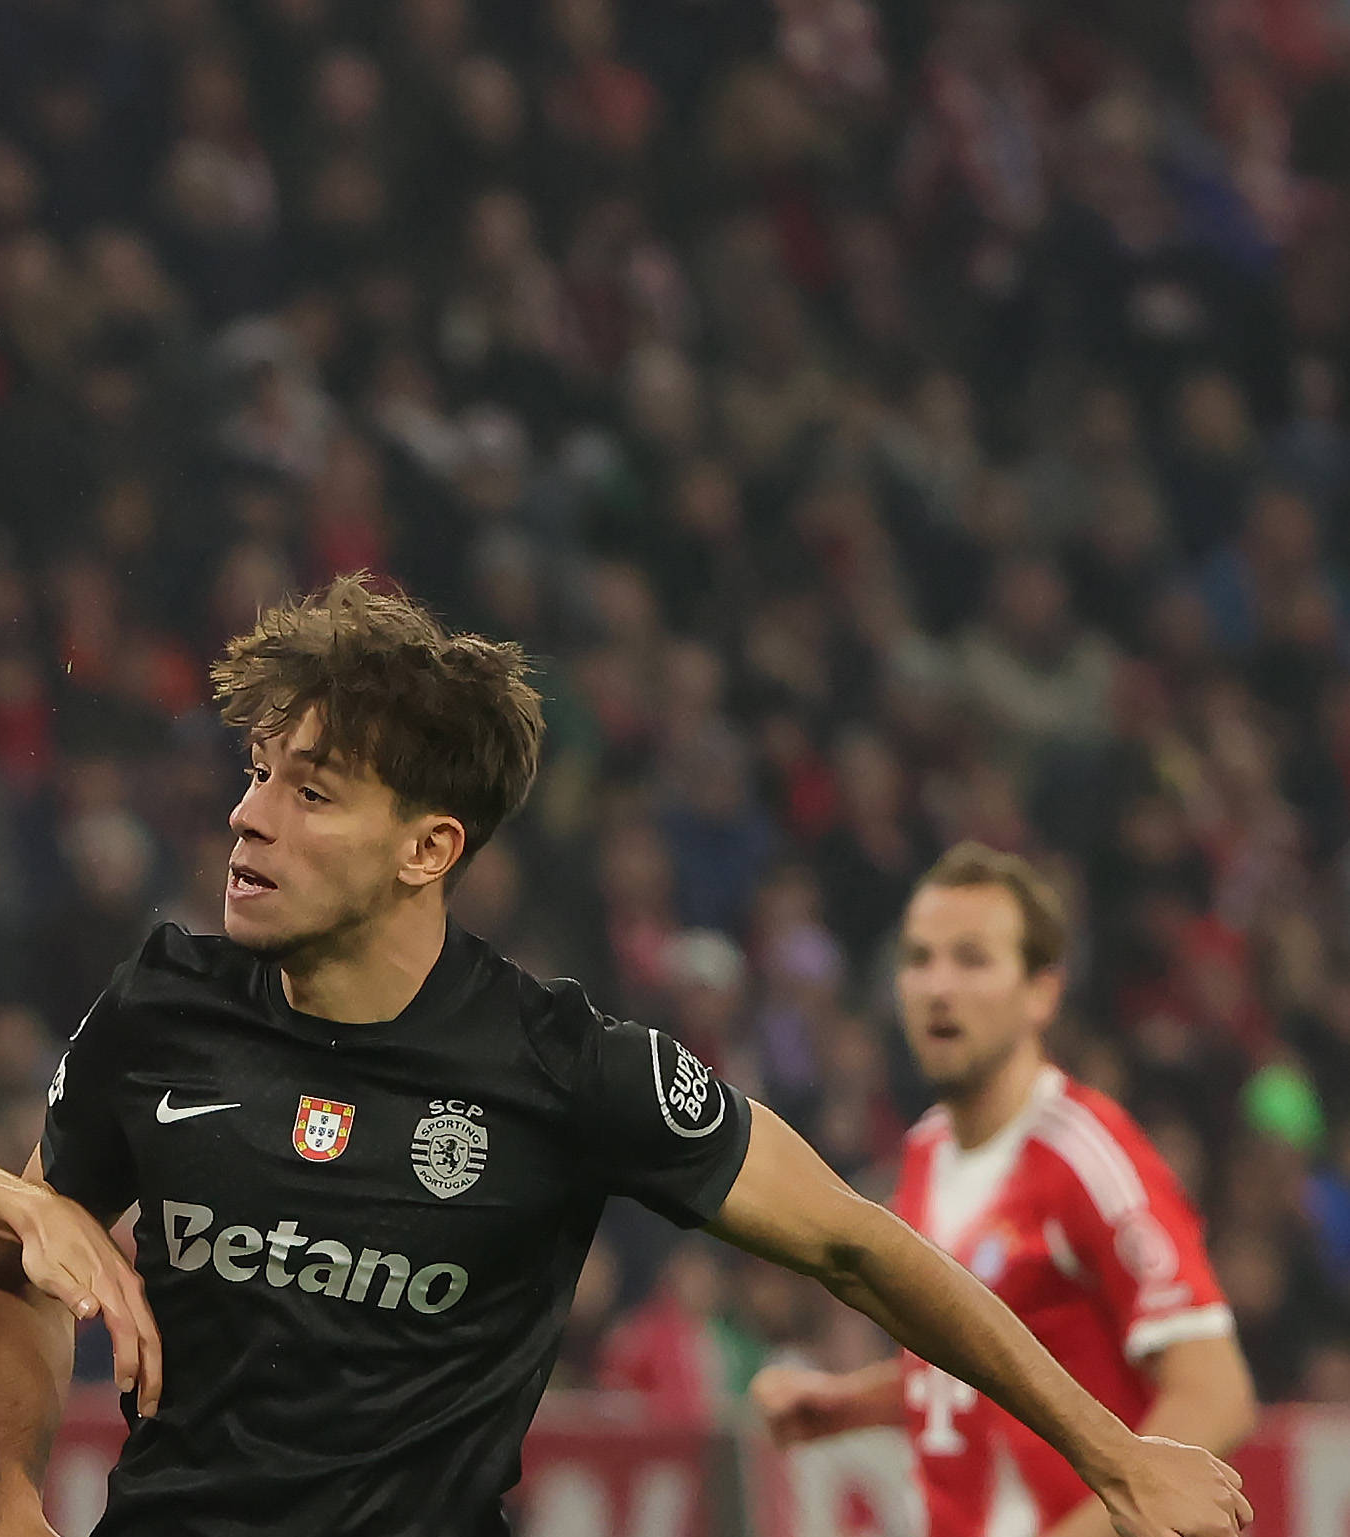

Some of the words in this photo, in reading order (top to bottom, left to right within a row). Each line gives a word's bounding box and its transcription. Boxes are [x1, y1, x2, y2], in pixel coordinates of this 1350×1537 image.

[684, 1056, 713, 1121] BOC
[428, 1099, 484, 1118] SCP
[421, 1119, 482, 1144] SPORTING
[419, 1170, 474, 1189] PORTUGAL
[163, 1199, 469, 1314] Betano
